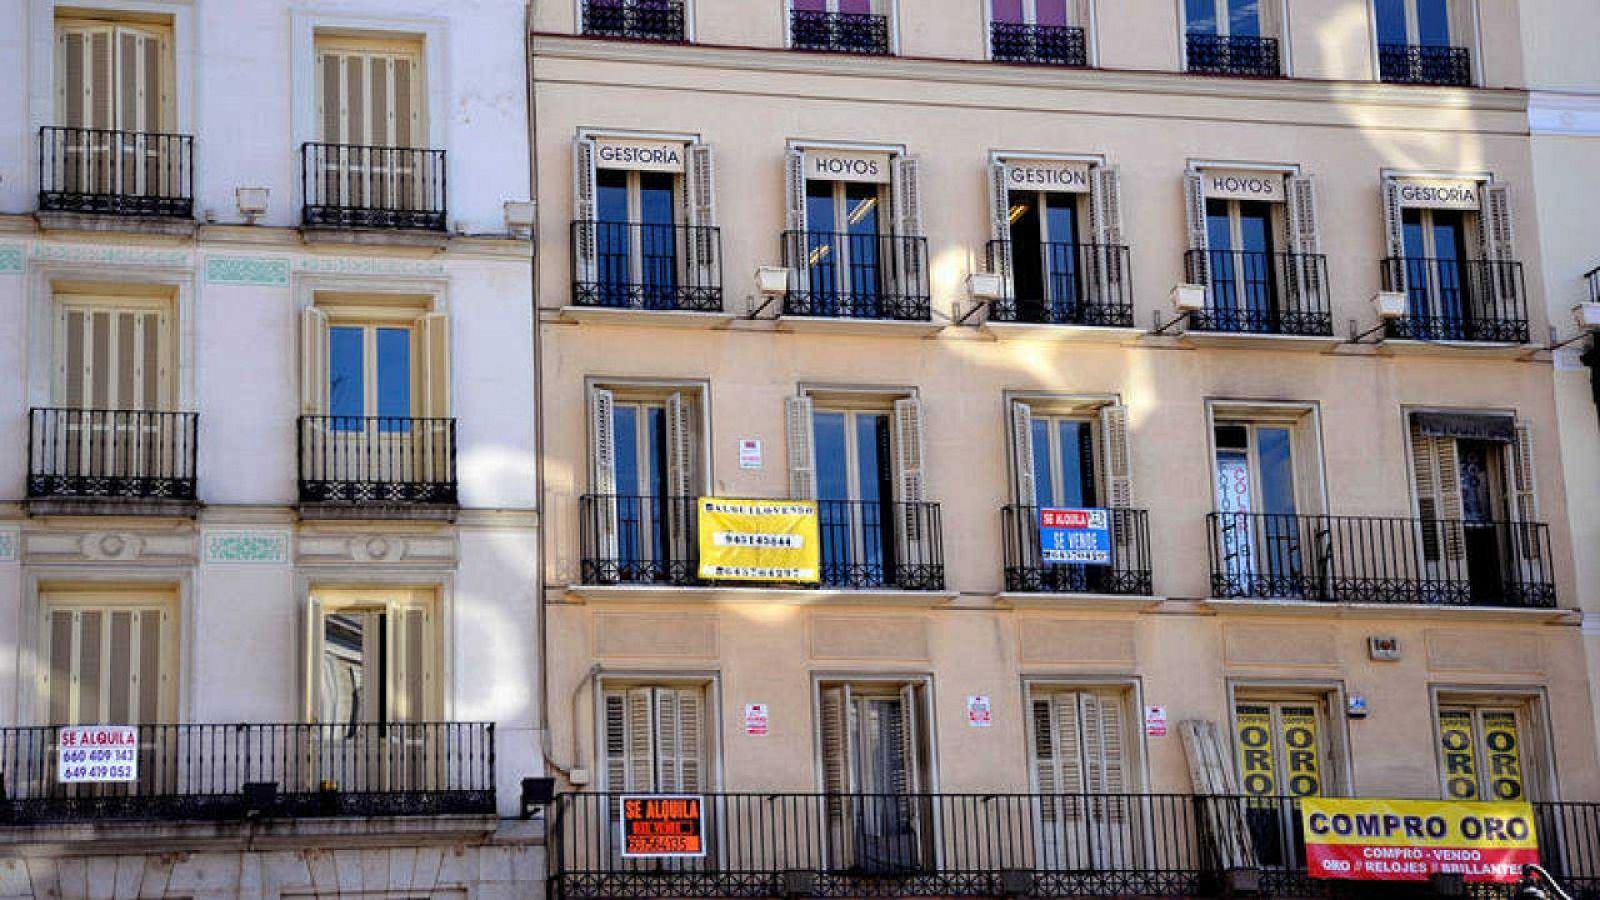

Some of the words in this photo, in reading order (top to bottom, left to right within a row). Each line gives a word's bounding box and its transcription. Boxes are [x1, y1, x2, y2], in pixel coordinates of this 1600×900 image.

[600, 145, 681, 165] GESTORÍA
[815, 156, 879, 176] HOYOS
[1213, 175, 1273, 194] HOYOS
[1402, 184, 1475, 203] GESTORÍA
[1043, 513, 1055, 525] SE
[1053, 532, 1065, 549] SE
[62, 731, 76, 746] SE
[81, 731, 135, 745] ALQUILA
[64, 748, 86, 763] 660
[1240, 726, 1273, 796] ORO
[1286, 728, 1319, 797] ORO
[1442, 730, 1475, 798] ORO
[1487, 731, 1521, 799] ORO
[64, 766, 87, 778] 649
[109, 766, 131, 778] 052
[625, 800, 642, 819] SE
[646, 799, 698, 820] ALQUILA
[1309, 811, 1447, 839] COMPRO
[1459, 815, 1530, 842] ORO
[1363, 847, 1422, 860] COMPRO
[1432, 849, 1482, 862] VENDO
[1323, 859, 1351, 872] ORO
[1365, 861, 1428, 874] RELOJES
